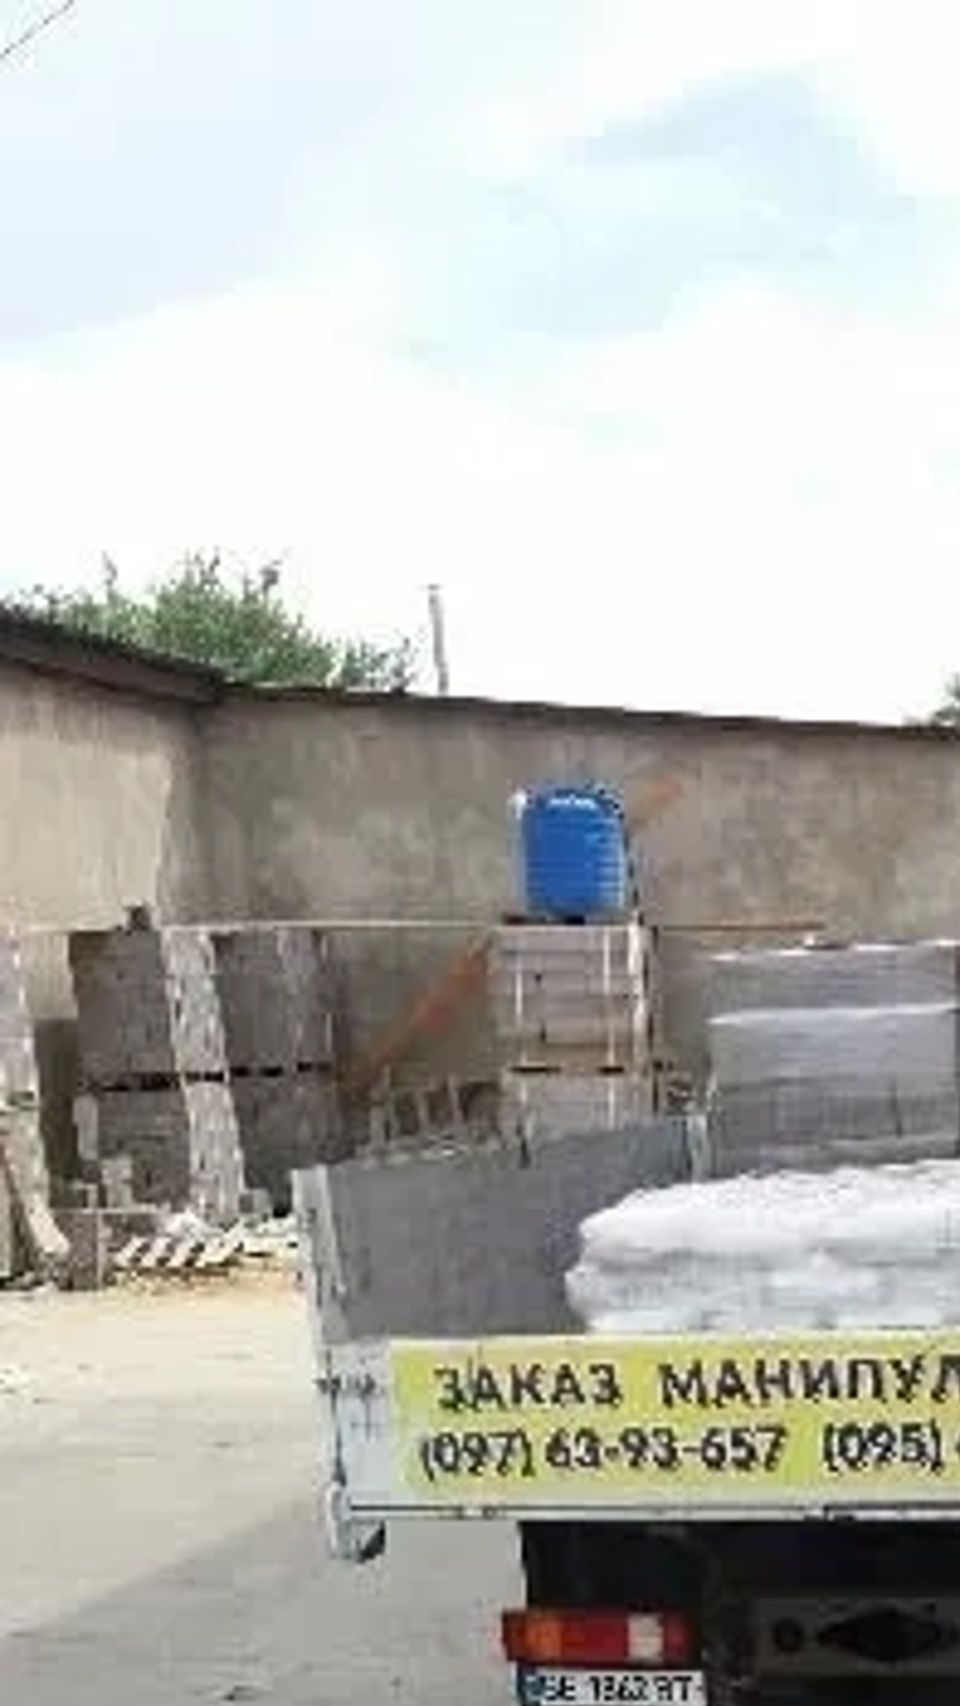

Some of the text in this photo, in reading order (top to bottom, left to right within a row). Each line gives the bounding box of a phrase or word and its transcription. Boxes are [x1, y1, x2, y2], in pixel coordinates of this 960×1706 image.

[434, 1362, 622, 1409] ЗАКАЗ
[421, 1429, 535, 1481] (097)
[546, 1424, 787, 1472] 63-93-657
[823, 1418, 943, 1474] (095)
